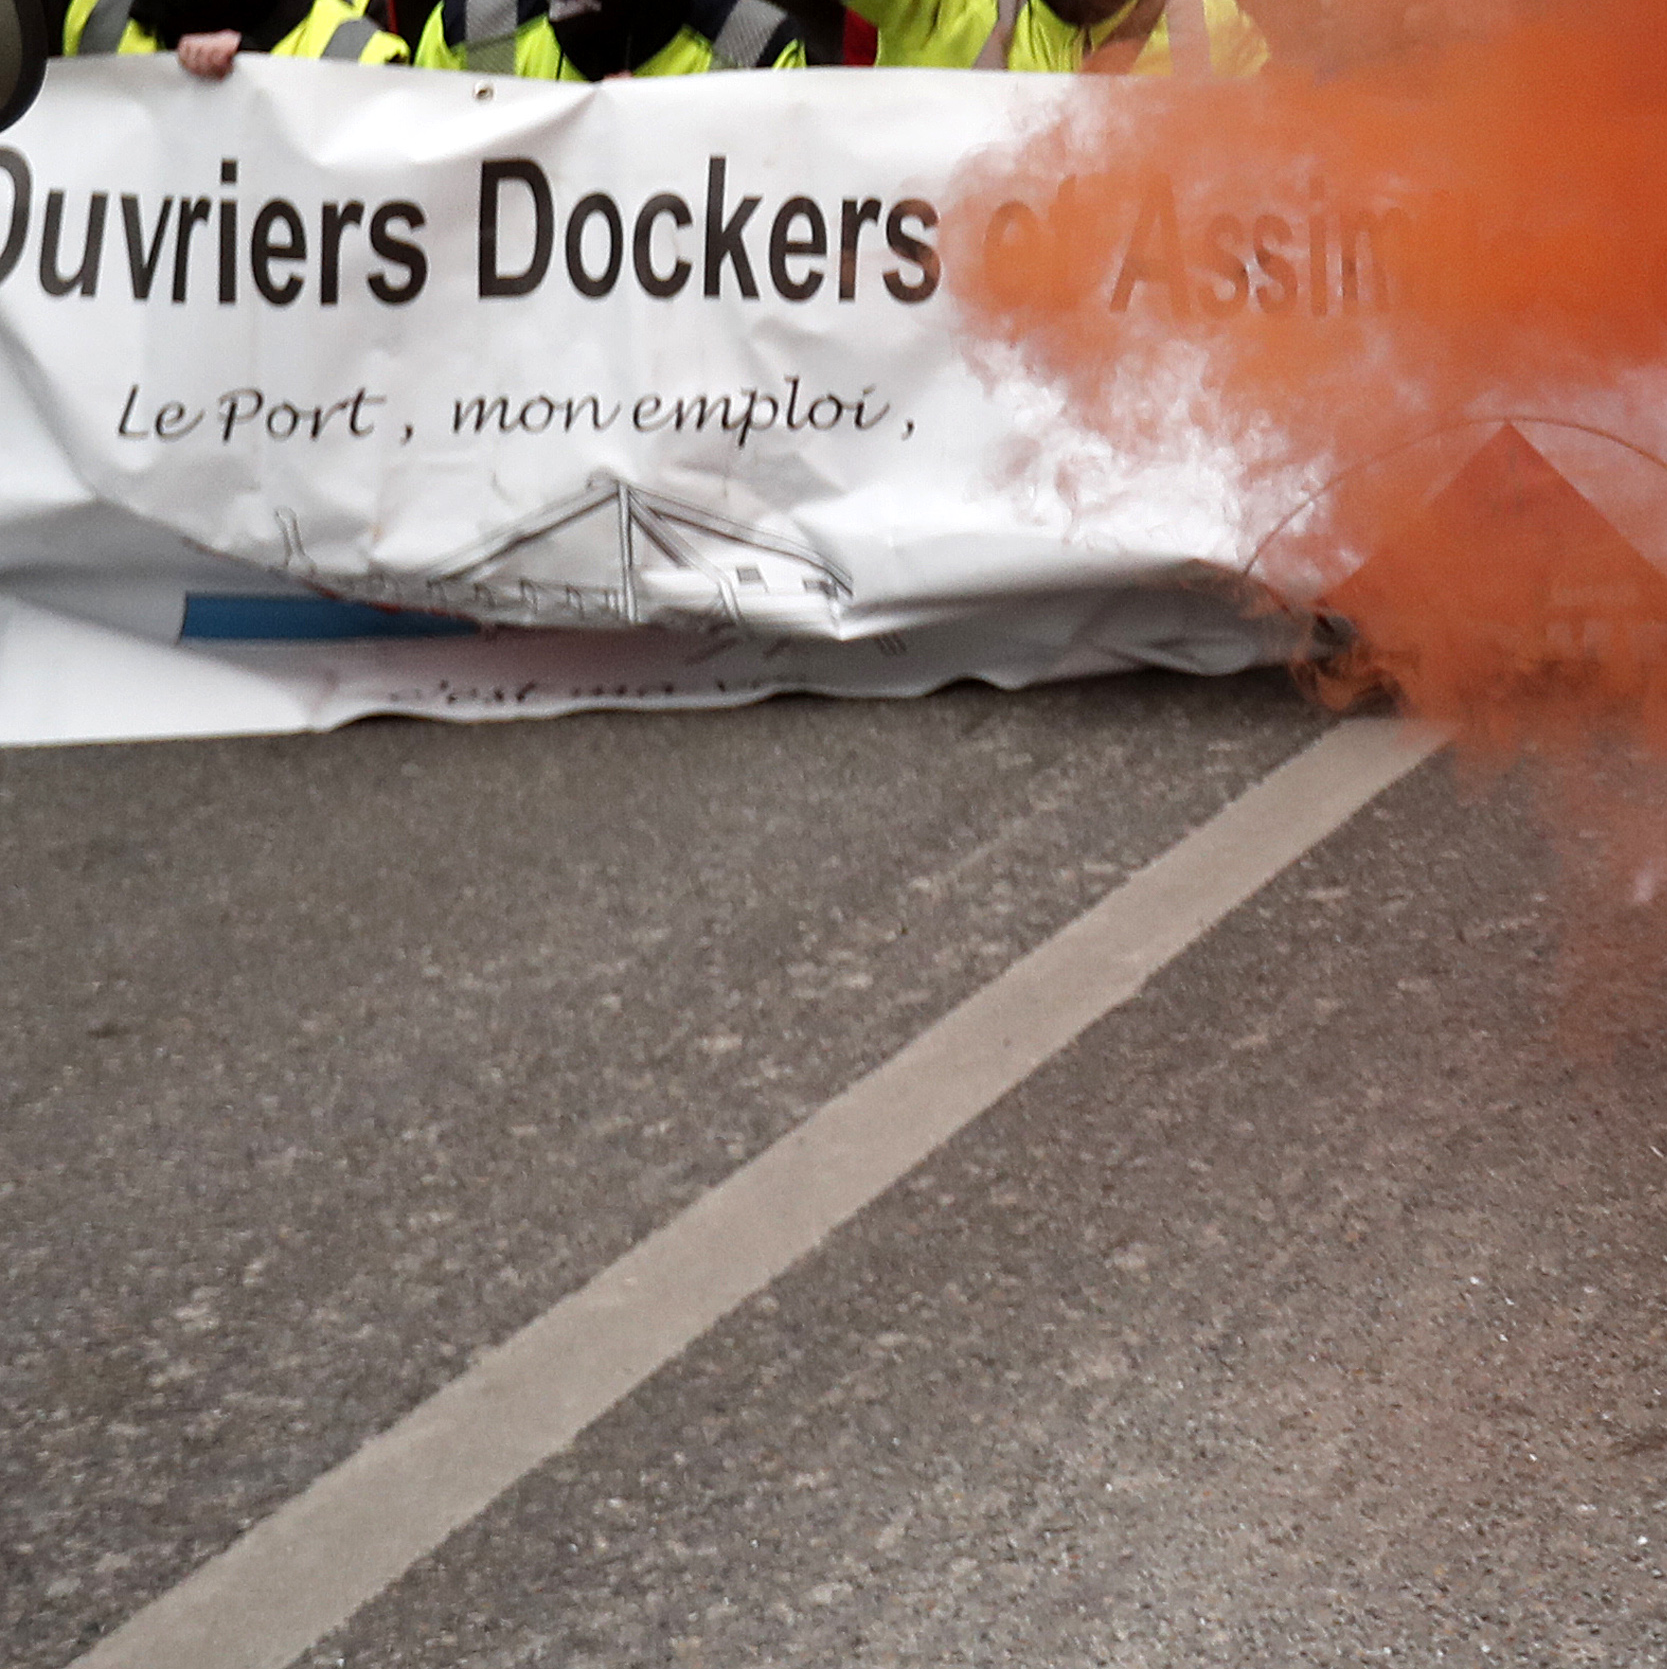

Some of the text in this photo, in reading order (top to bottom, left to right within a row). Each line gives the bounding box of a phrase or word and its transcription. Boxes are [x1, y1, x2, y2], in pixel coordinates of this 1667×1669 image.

[477, 156, 941, 304] Dockers
[115, 383, 205, 440] Le
[450, 392, 622, 434] mon
[631, 375, 918, 451] emploi,
